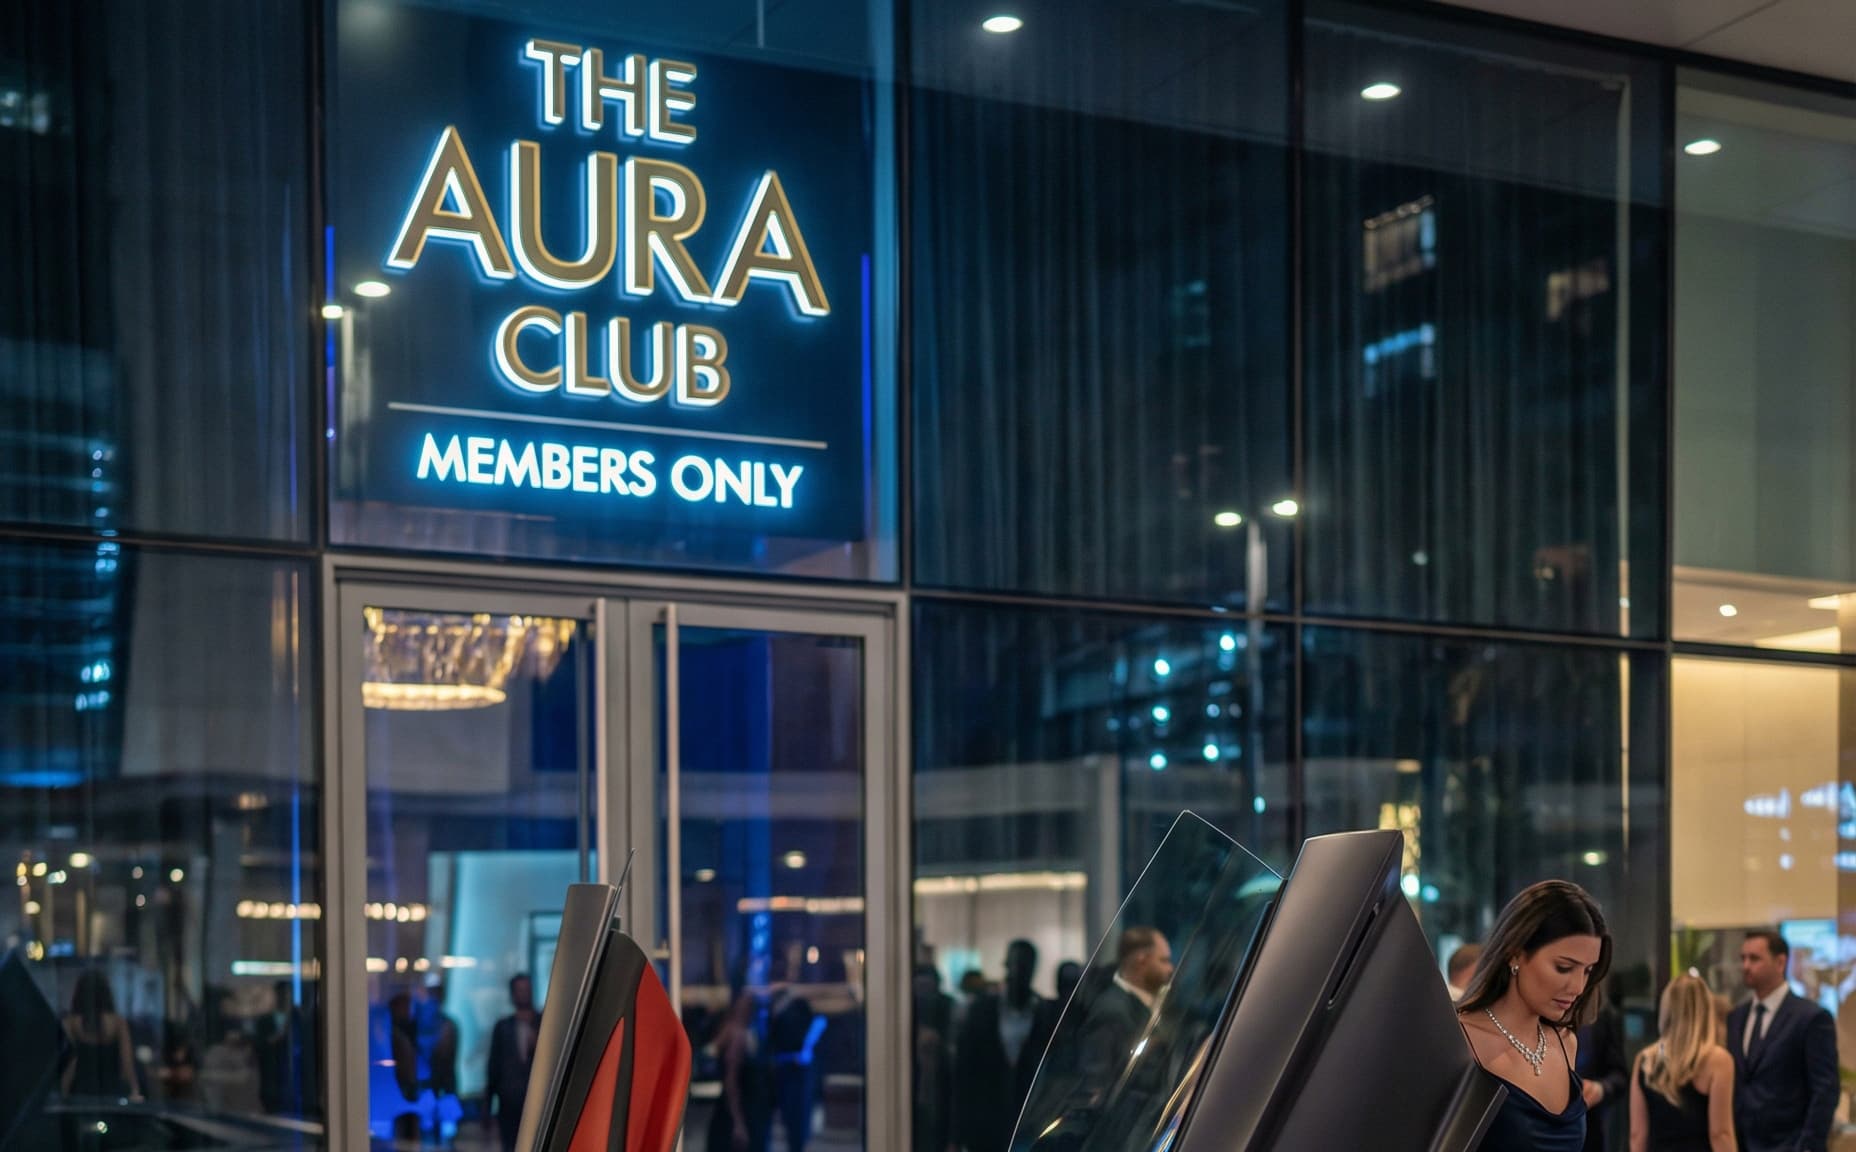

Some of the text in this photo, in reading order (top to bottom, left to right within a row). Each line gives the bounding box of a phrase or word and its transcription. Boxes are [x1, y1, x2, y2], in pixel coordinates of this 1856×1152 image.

[526, 38, 697, 144] THE
[387, 125, 831, 317] AURA
[495, 305, 731, 407] CLUB
[416, 432, 803, 508] MEMBERS ONLY
